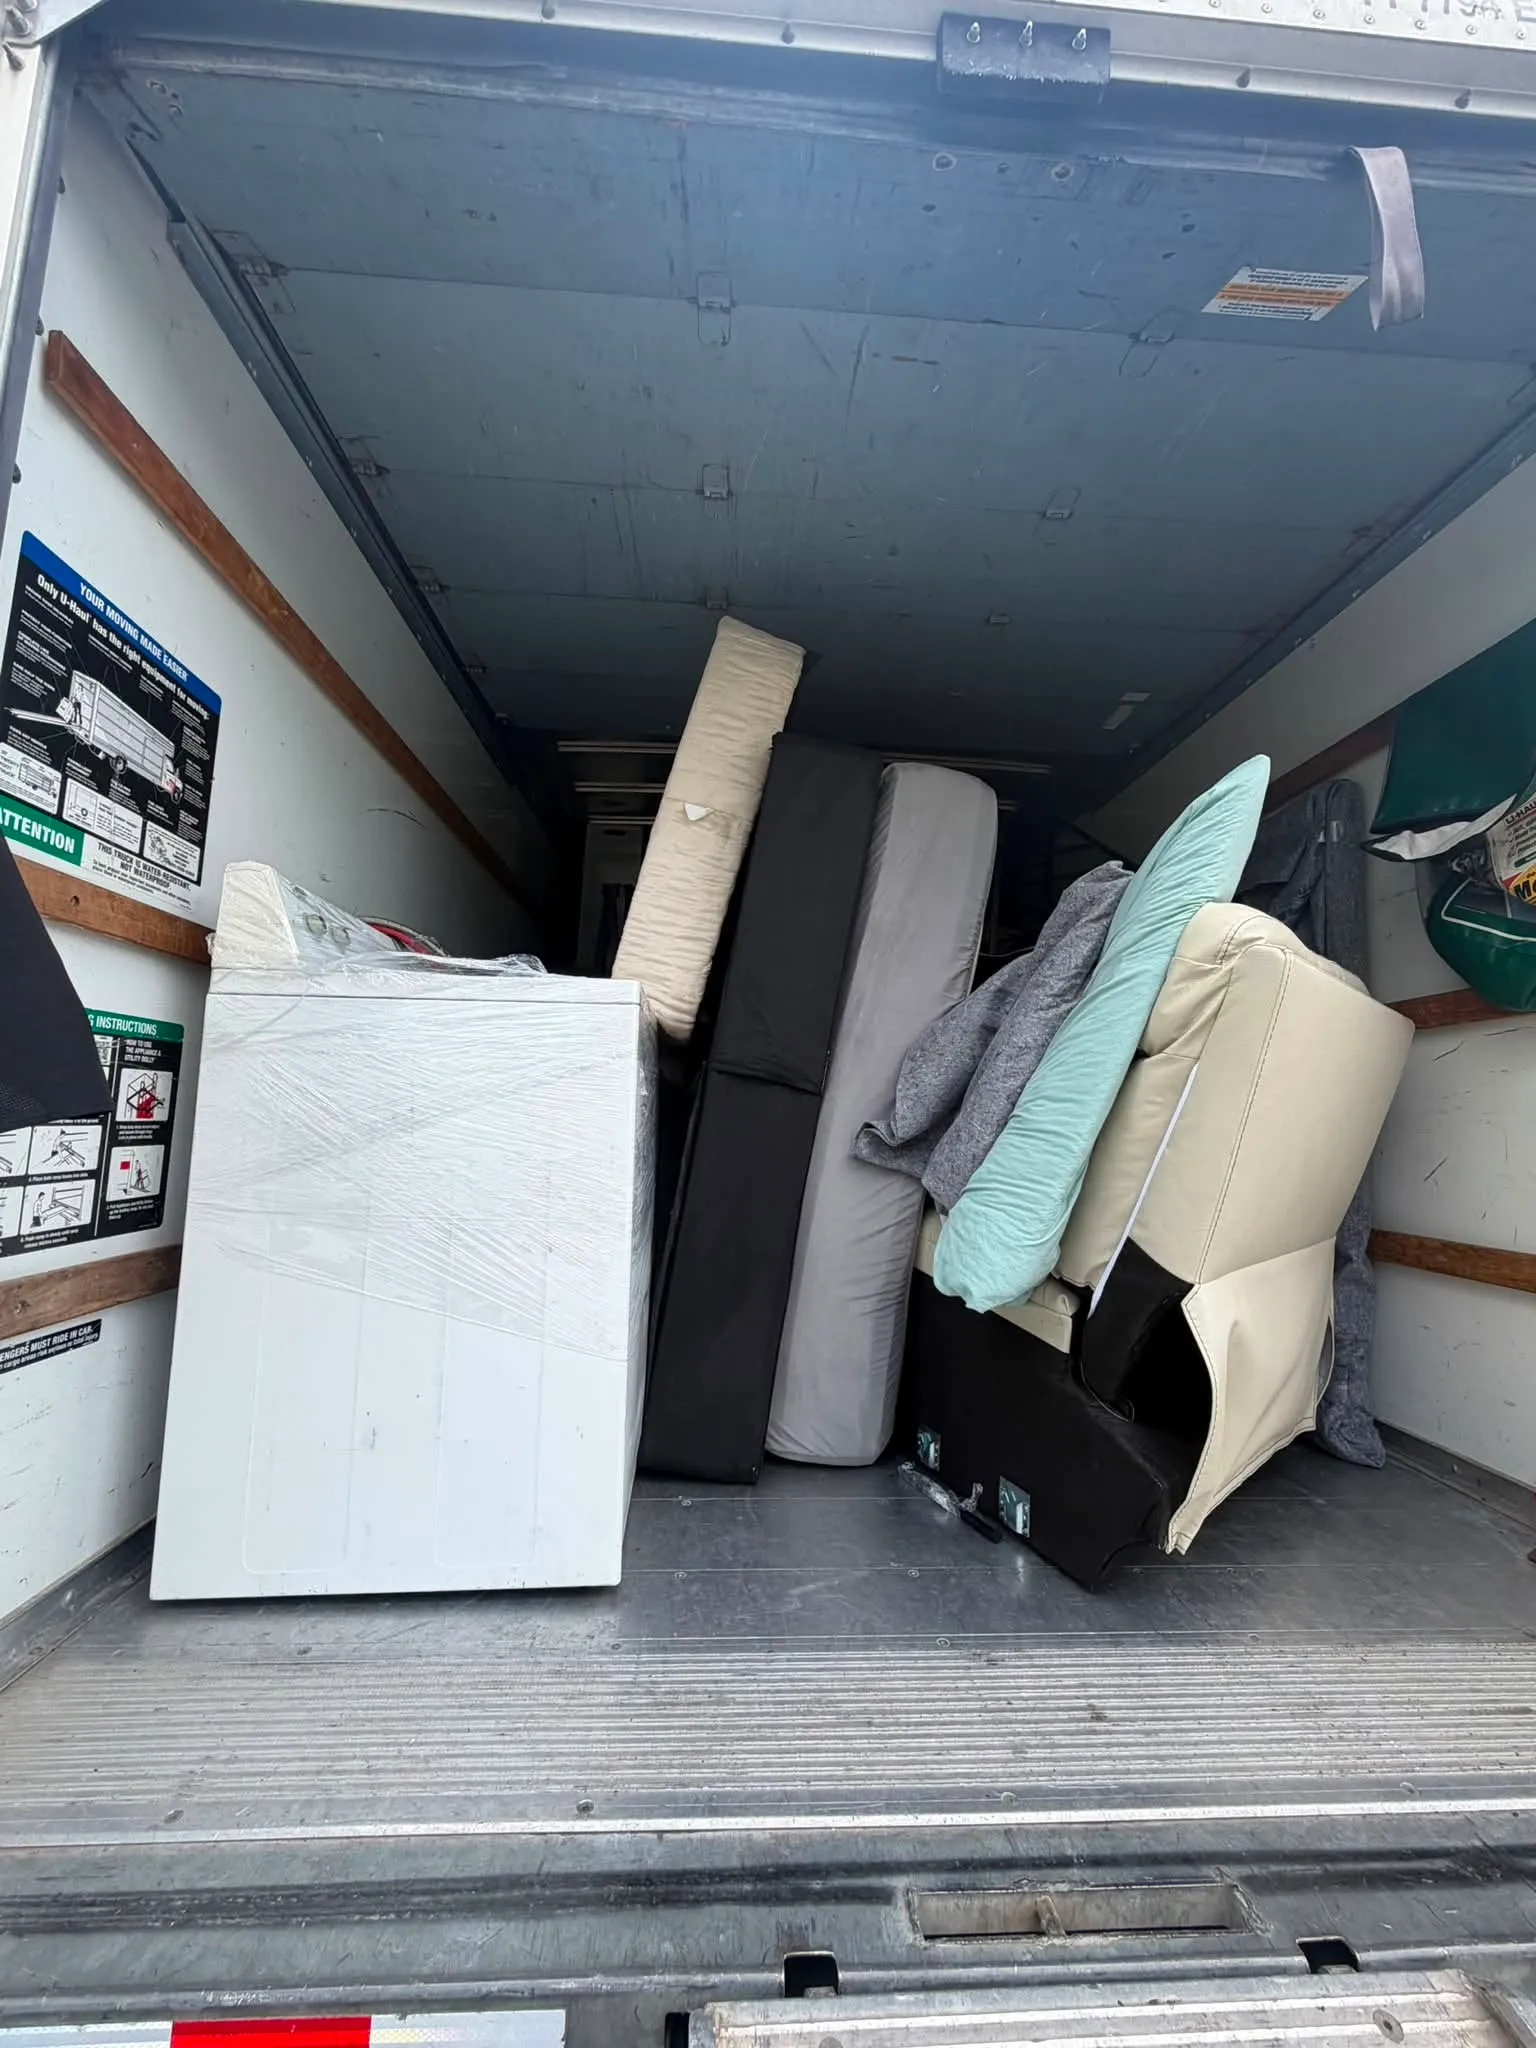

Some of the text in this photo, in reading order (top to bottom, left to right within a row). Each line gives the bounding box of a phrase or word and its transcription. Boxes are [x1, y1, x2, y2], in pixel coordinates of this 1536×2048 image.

[37, 574, 59, 600] Only
[60, 592, 89, 623] U-Haul
[92, 618, 108, 638] has
[108, 632, 122, 649] the
[122, 644, 141, 665] right
[141, 660, 176, 694] equipment
[176, 688, 187, 701] for
[80, 582, 104, 612] YOUR
[105, 605, 139, 641] MOVING
[140, 634, 162, 661] MADE
[162, 654, 188, 682] EASIER
[97, 842, 112, 855] THIS
[114, 850, 134, 864] TRUCK
[135, 859, 141, 869] IS
[142, 862, 161, 878] WATER
[120, 860, 132, 873] NOT
[96, 1016, 157, 1036] INSTRUCTIONS
[30, 1339, 51, 1352] MUST
[52, 1332, 69, 1344] RIDE
[69, 1330, 78, 1340] IN
[4, 1357, 20, 1369] cargo
